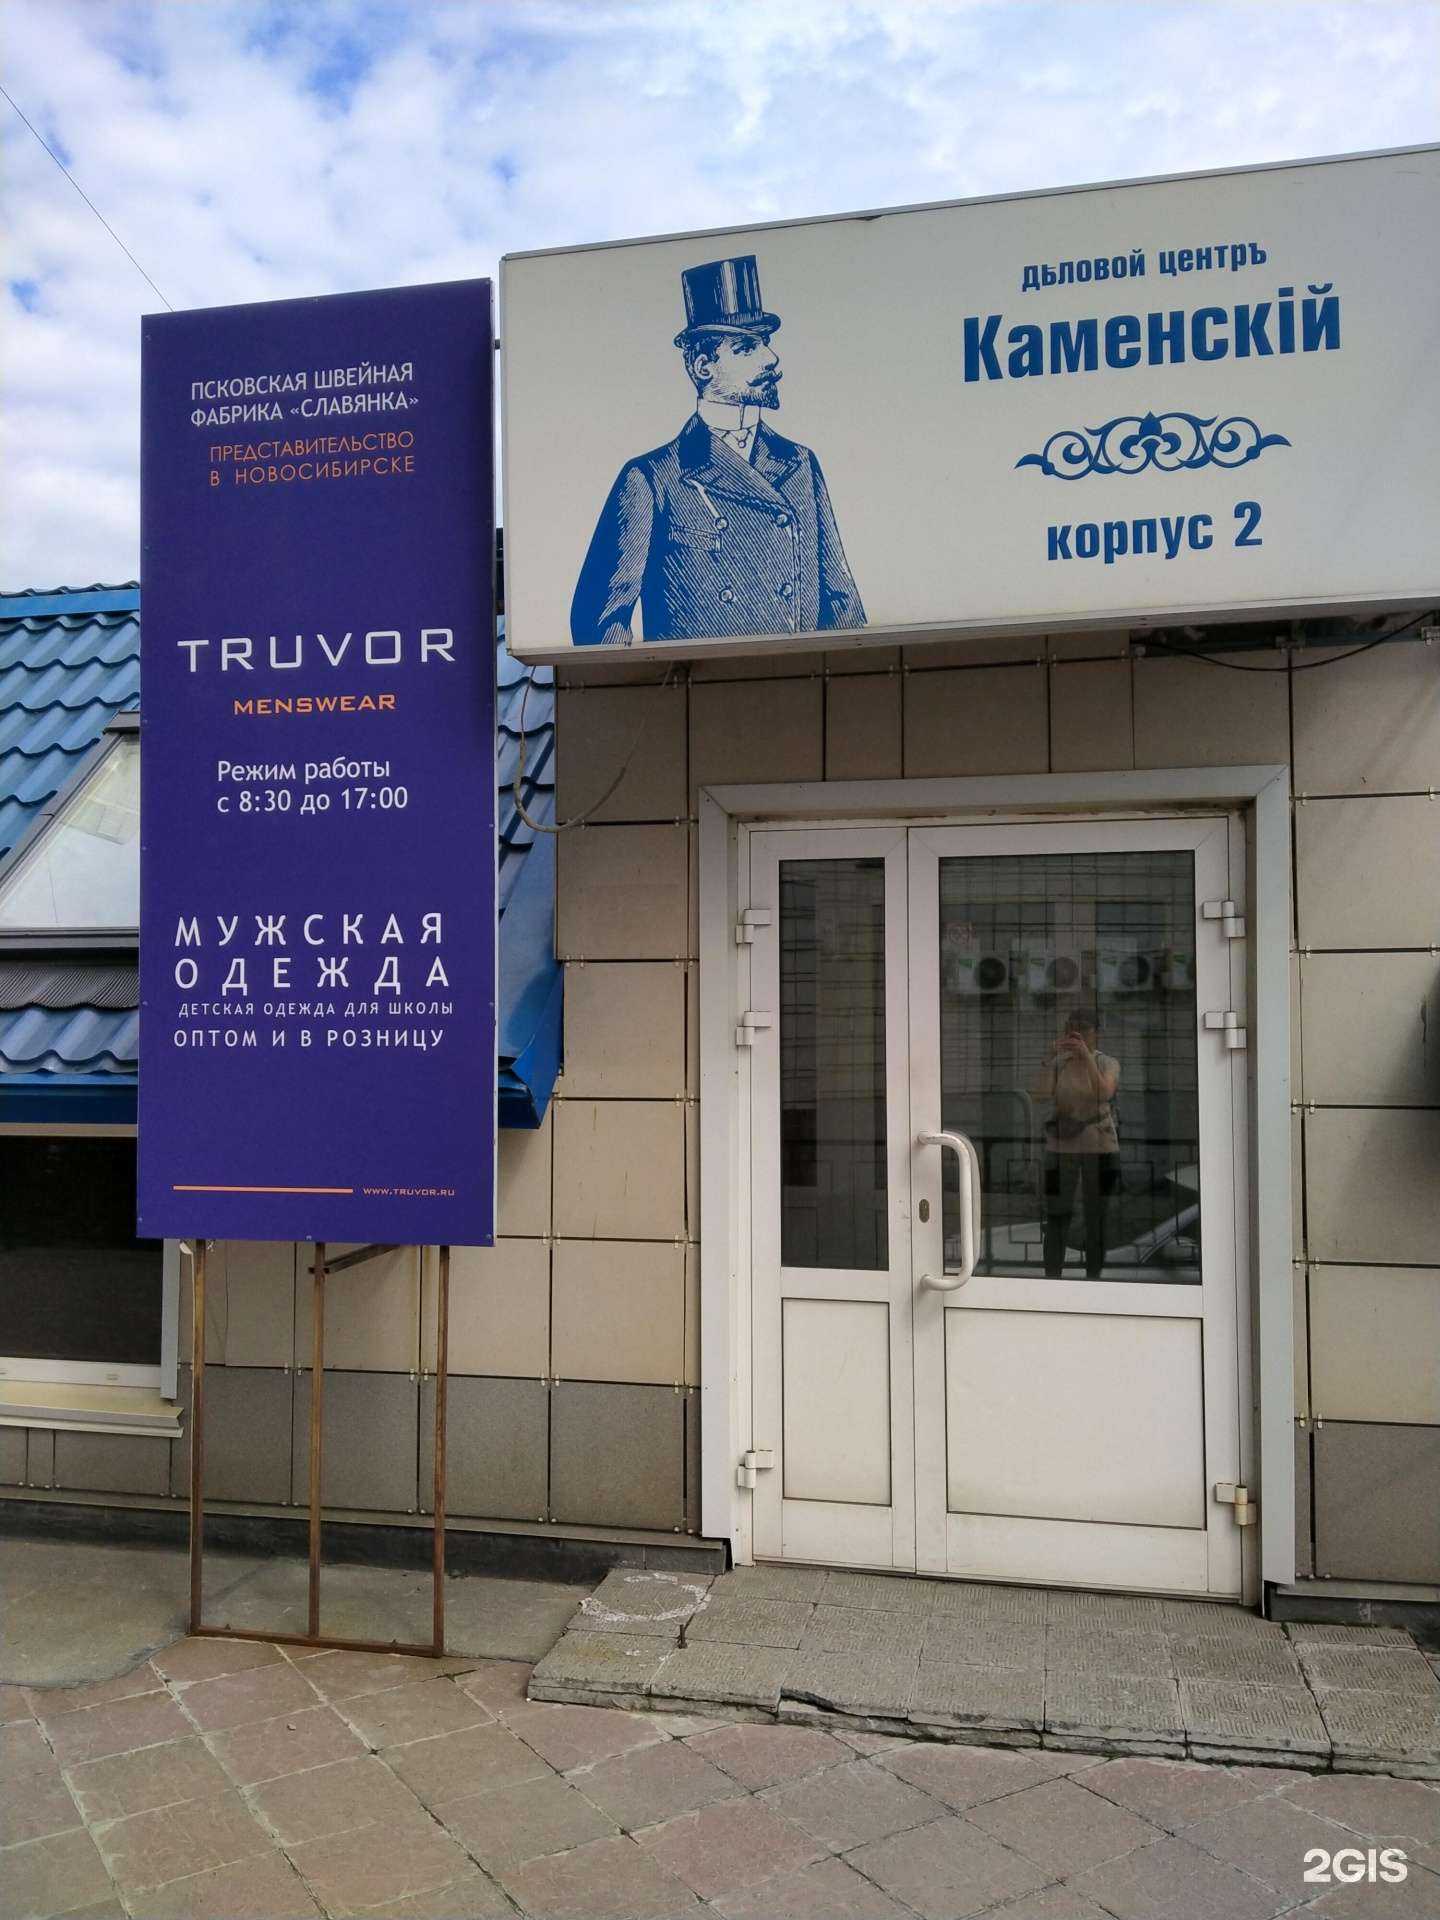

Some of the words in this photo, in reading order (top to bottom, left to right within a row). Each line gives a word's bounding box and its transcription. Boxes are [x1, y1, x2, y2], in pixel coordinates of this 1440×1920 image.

[1159, 242, 1267, 277] центръ
[191, 372, 307, 401] ПСКОВСКАЯ
[314, 361, 413, 390] ШВЕЙНАЯ
[190, 401, 284, 428] ФАБРИКА
[290, 391, 419, 418] «СЛАВЯНКА»
[210, 430, 414, 463] ПРЕДСТАВИТЕЛЬСТВО
[210, 470, 220, 487] В
[235, 455, 415, 485] НОВОСИБИРСКЕ
[1047, 514, 1214, 565] корпус
[1233, 501, 1263, 547] 2
[177, 628, 456, 673] TRUVOR
[234, 694, 396, 715] MENSWEAR
[218, 760, 297, 782] Режим
[304, 756, 390, 785] работы
[217, 796, 230, 813] с
[239, 789, 291, 813] 8:30
[300, 793, 331, 816] до
[341, 786, 408, 810] 17:00
[174, 912, 443, 947] МУЖСКАЯ
[174, 955, 449, 997] ОДЕЖДА
[178, 1002, 254, 1018] ДЕТСКАЯ
[263, 1002, 336, 1018] ОДЕЖДА
[344, 1001, 379, 1018] ДЛЯ
[388, 1001, 453, 1016] ШКОЛЫ
[173, 1029, 257, 1047] ОПТОМ
[272, 1029, 285, 1047] И
[300, 1029, 312, 1047] В
[327, 1029, 444, 1052] РОЗНИЦУ
